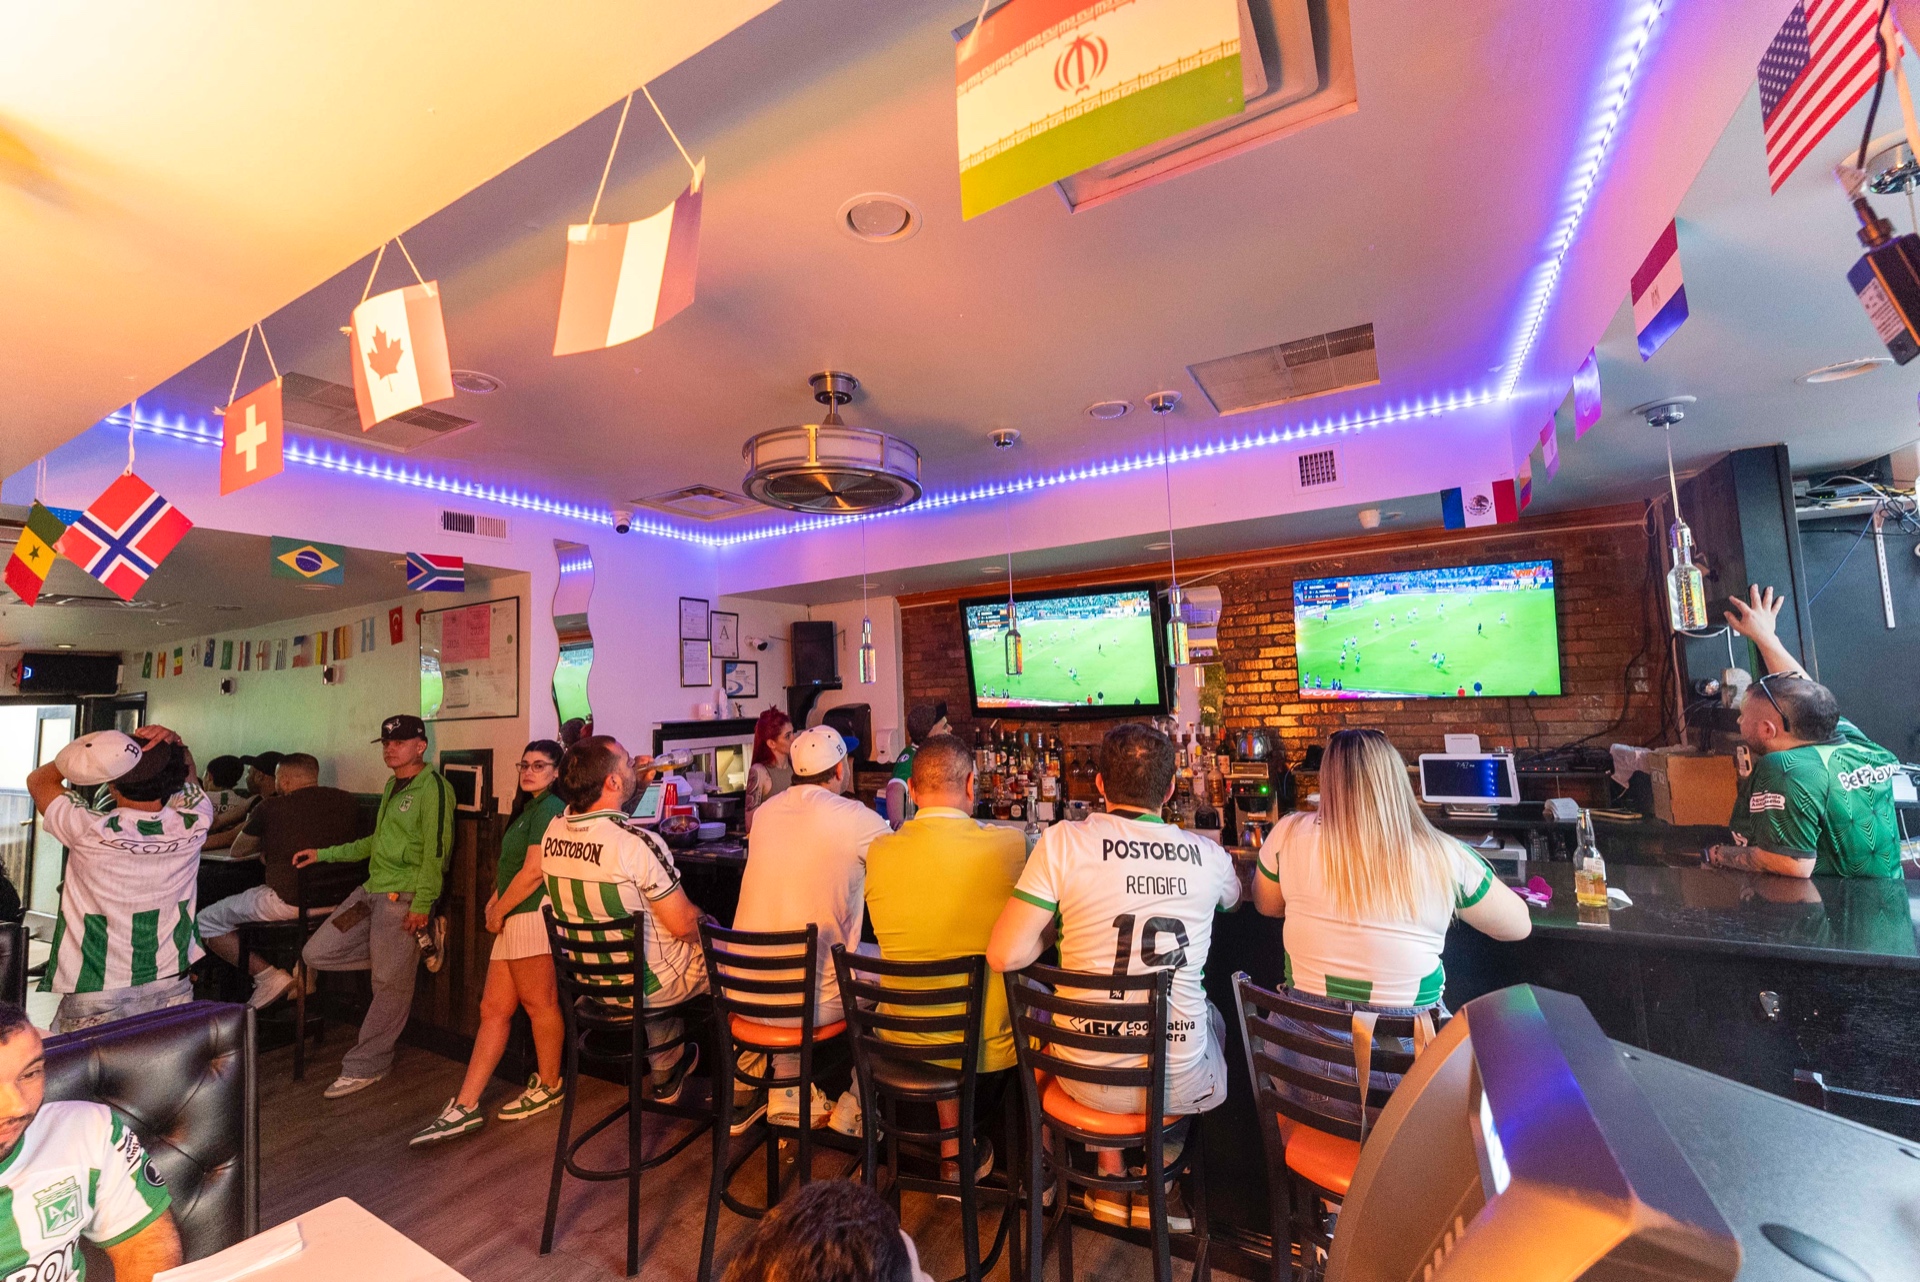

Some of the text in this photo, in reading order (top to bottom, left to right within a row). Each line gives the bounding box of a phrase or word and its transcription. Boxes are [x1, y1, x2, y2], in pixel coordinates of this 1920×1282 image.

[719, 625, 729, 639] A
[543, 837, 604, 867] POSTOBON
[1102, 839, 1203, 867] POSTOBON
[1126, 875, 1188, 896] RENGIFO
